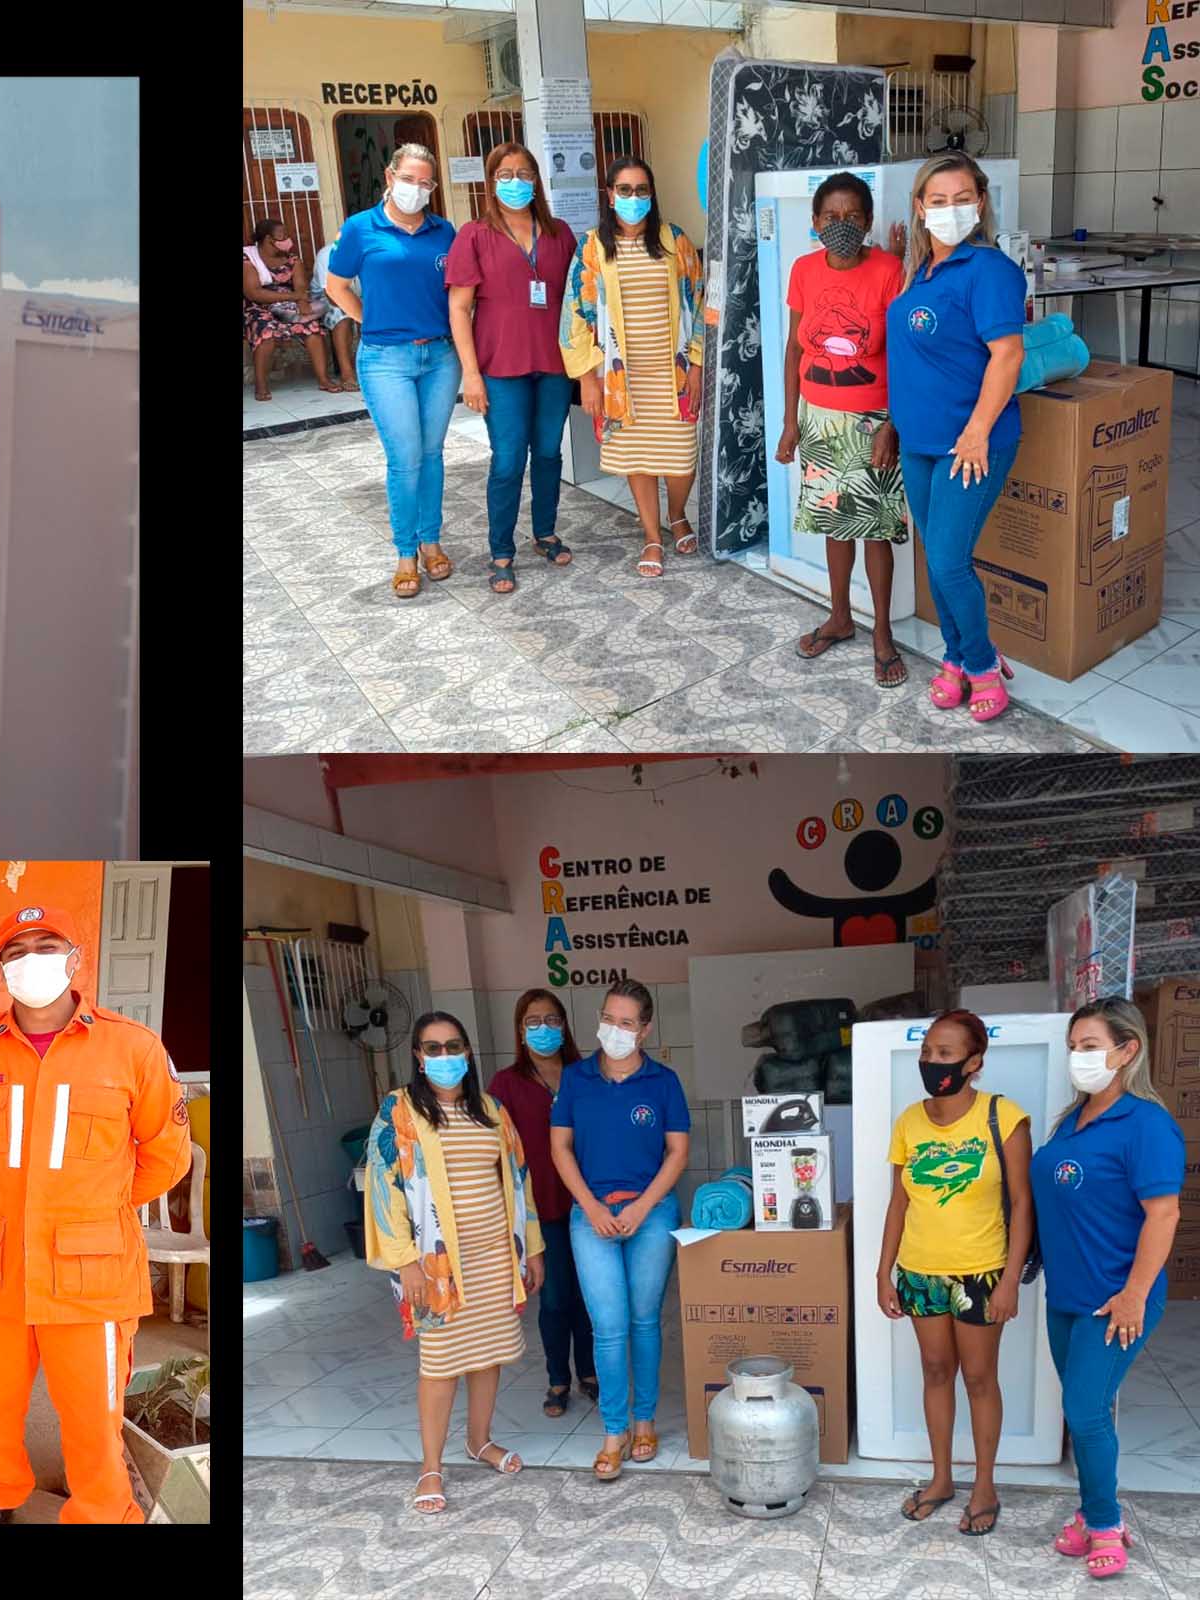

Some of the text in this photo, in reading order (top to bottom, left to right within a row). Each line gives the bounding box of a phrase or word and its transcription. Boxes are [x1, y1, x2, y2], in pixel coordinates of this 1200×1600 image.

[1141, 26, 1200, 65] ASS
[321, 79, 438, 107] RECEPÇÃO
[1141, 65, 1198, 101] SOC
[1093, 407, 1161, 449] Esmaltec
[539, 846, 667, 879] CENTRO DE
[541, 880, 711, 914] REFERÊNCIA DE
[545, 916, 689, 952] ASSISTÊNCIA
[753, 1139, 798, 1148] MONDIAL
[720, 1259, 799, 1274] Esmaltec
